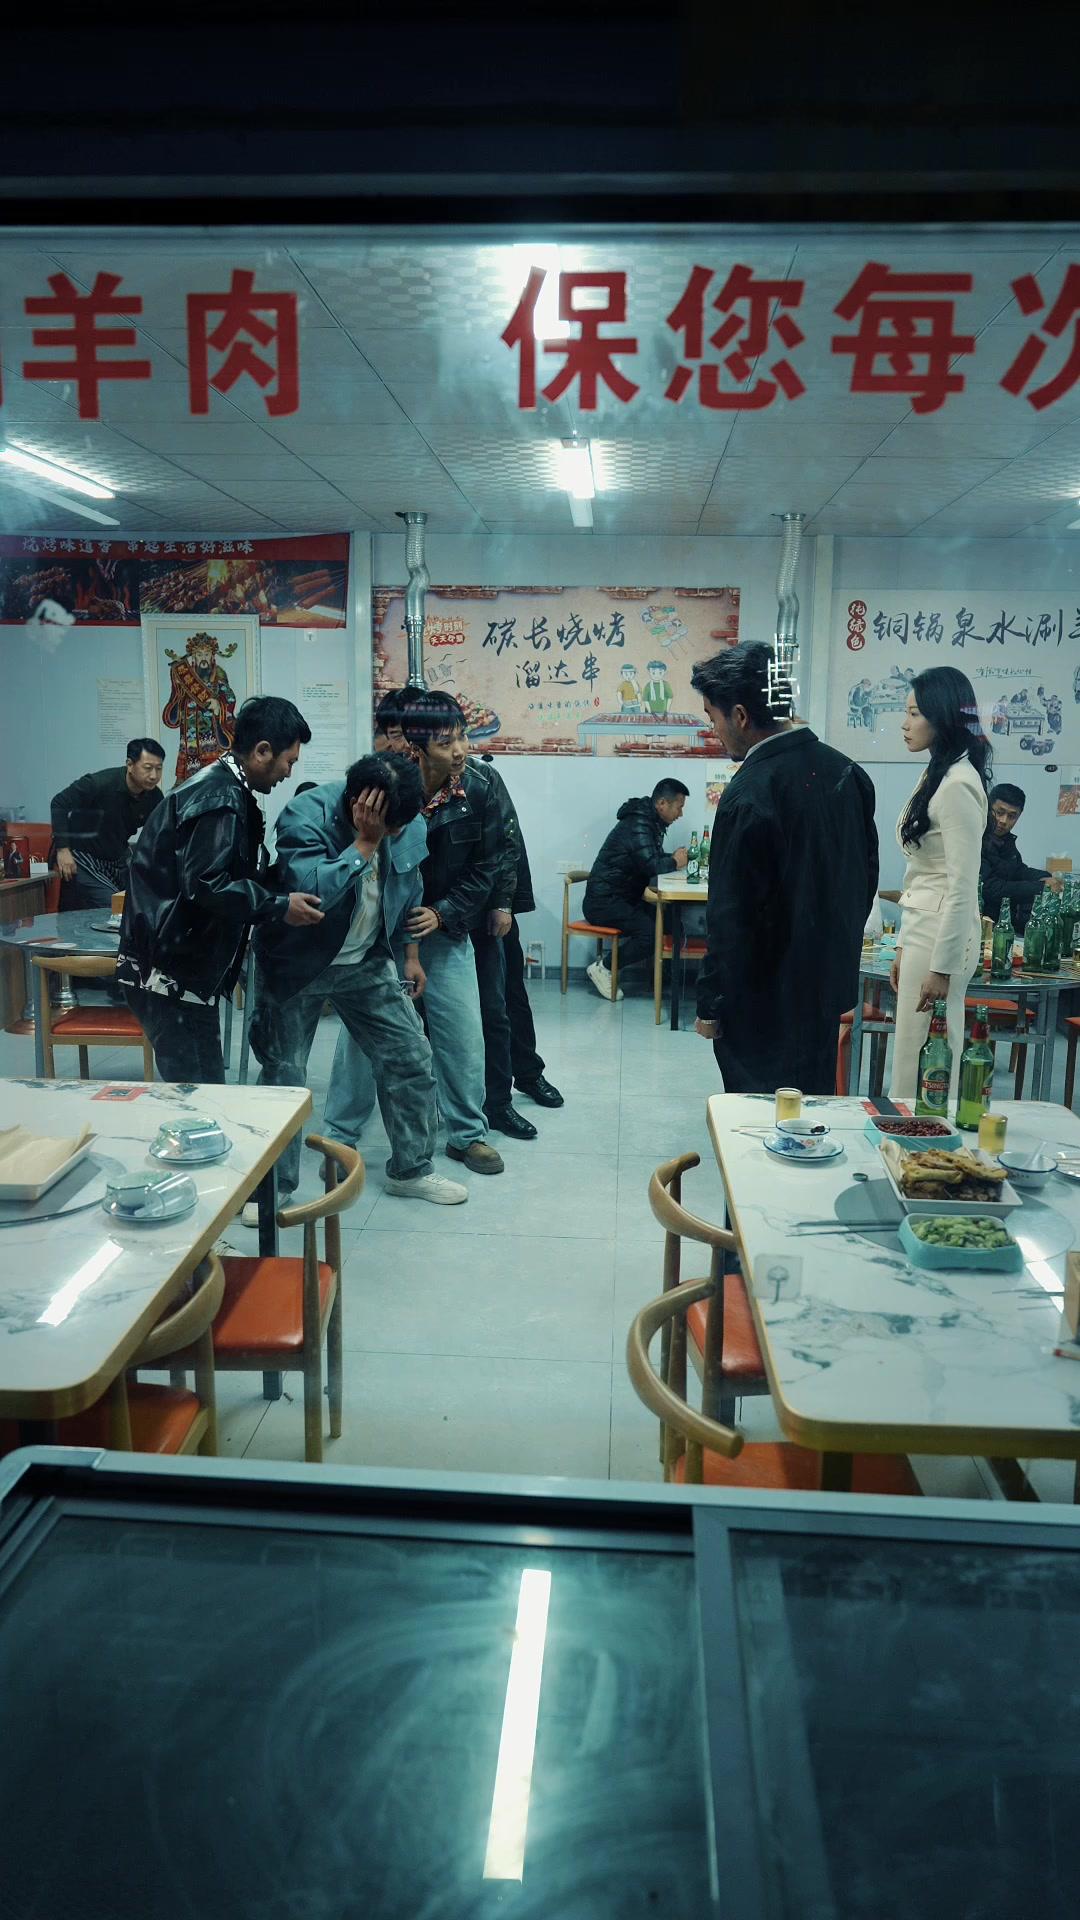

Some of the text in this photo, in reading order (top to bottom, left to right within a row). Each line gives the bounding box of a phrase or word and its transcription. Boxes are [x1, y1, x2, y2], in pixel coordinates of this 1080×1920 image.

[22, 260, 1080, 420] 羊肉 保您每次
[424, 619, 463, 636] 烤时刻
[482, 611, 626, 656] 碳长烧烤
[515, 650, 601, 693] 溜达串
[924, 1081, 950, 1090] TSING
